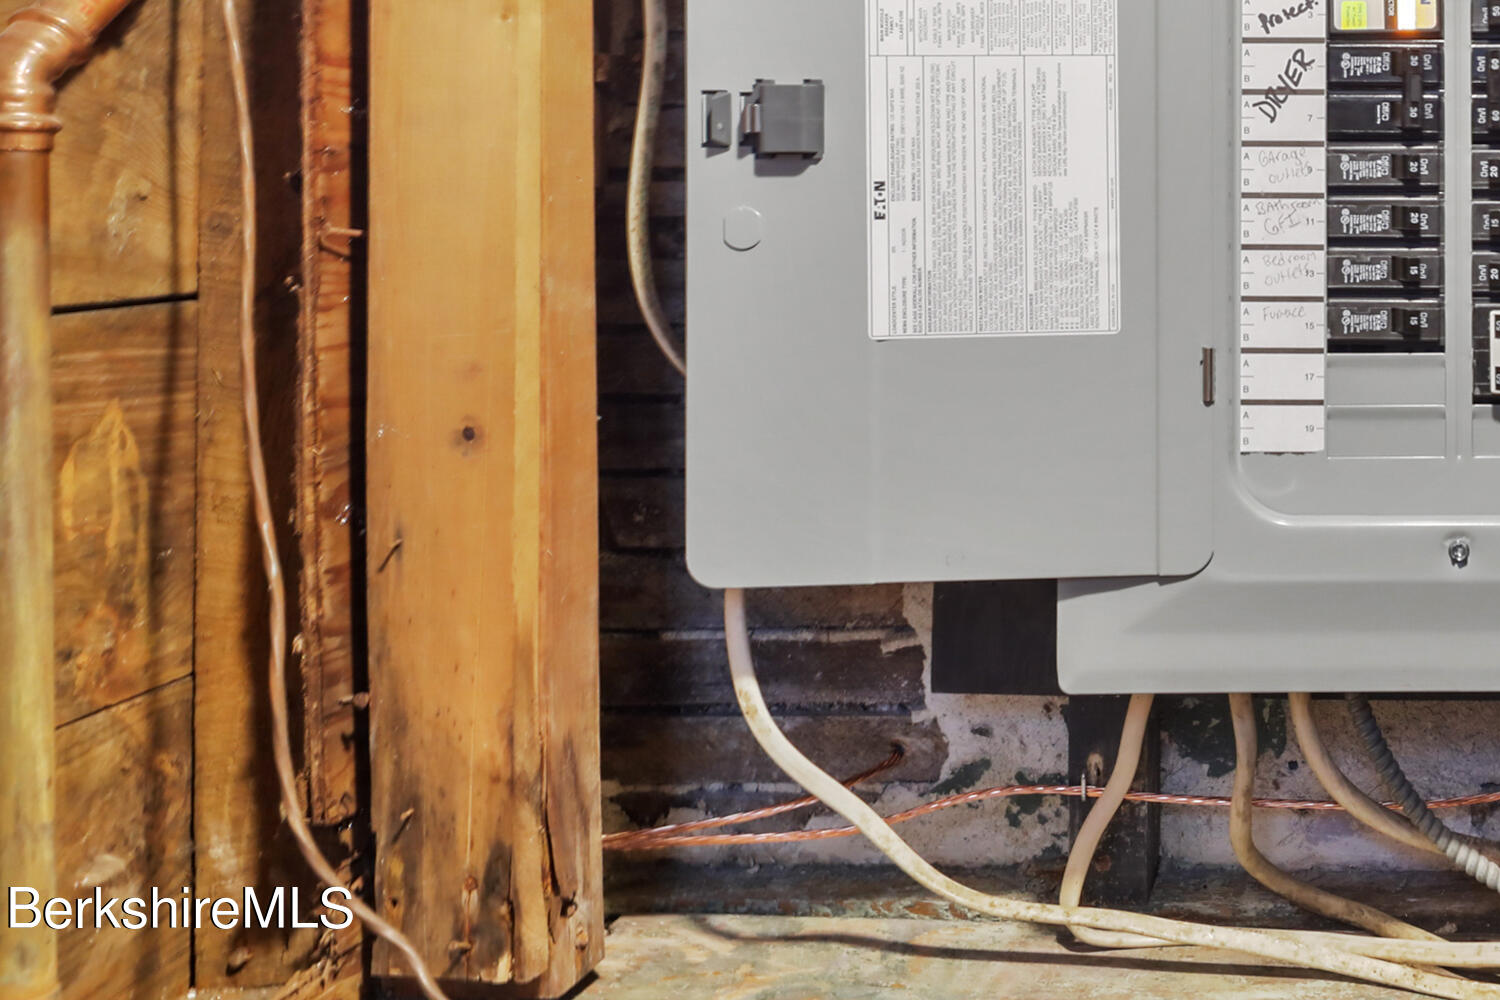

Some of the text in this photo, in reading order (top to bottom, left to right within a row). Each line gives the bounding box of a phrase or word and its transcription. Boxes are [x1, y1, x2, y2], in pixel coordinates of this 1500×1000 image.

[1492, 6, 1500, 16] 50
[1244, 23, 1250, 31] B
[1410, 56, 1417, 66] 30
[1410, 107, 1417, 118] 30
[1410, 162, 1417, 172] 20
[1490, 166, 1498, 177] 20
[874, 181, 885, 220] EATON
[1411, 213, 1418, 223] 20
[1491, 219, 1499, 227] 15
[1410, 266, 1418, 274] 15
[1491, 268, 1499, 280] 20
[1410, 317, 1418, 325] 15
[1243, 411, 1249, 419] A
[1243, 437, 1249, 445] B
